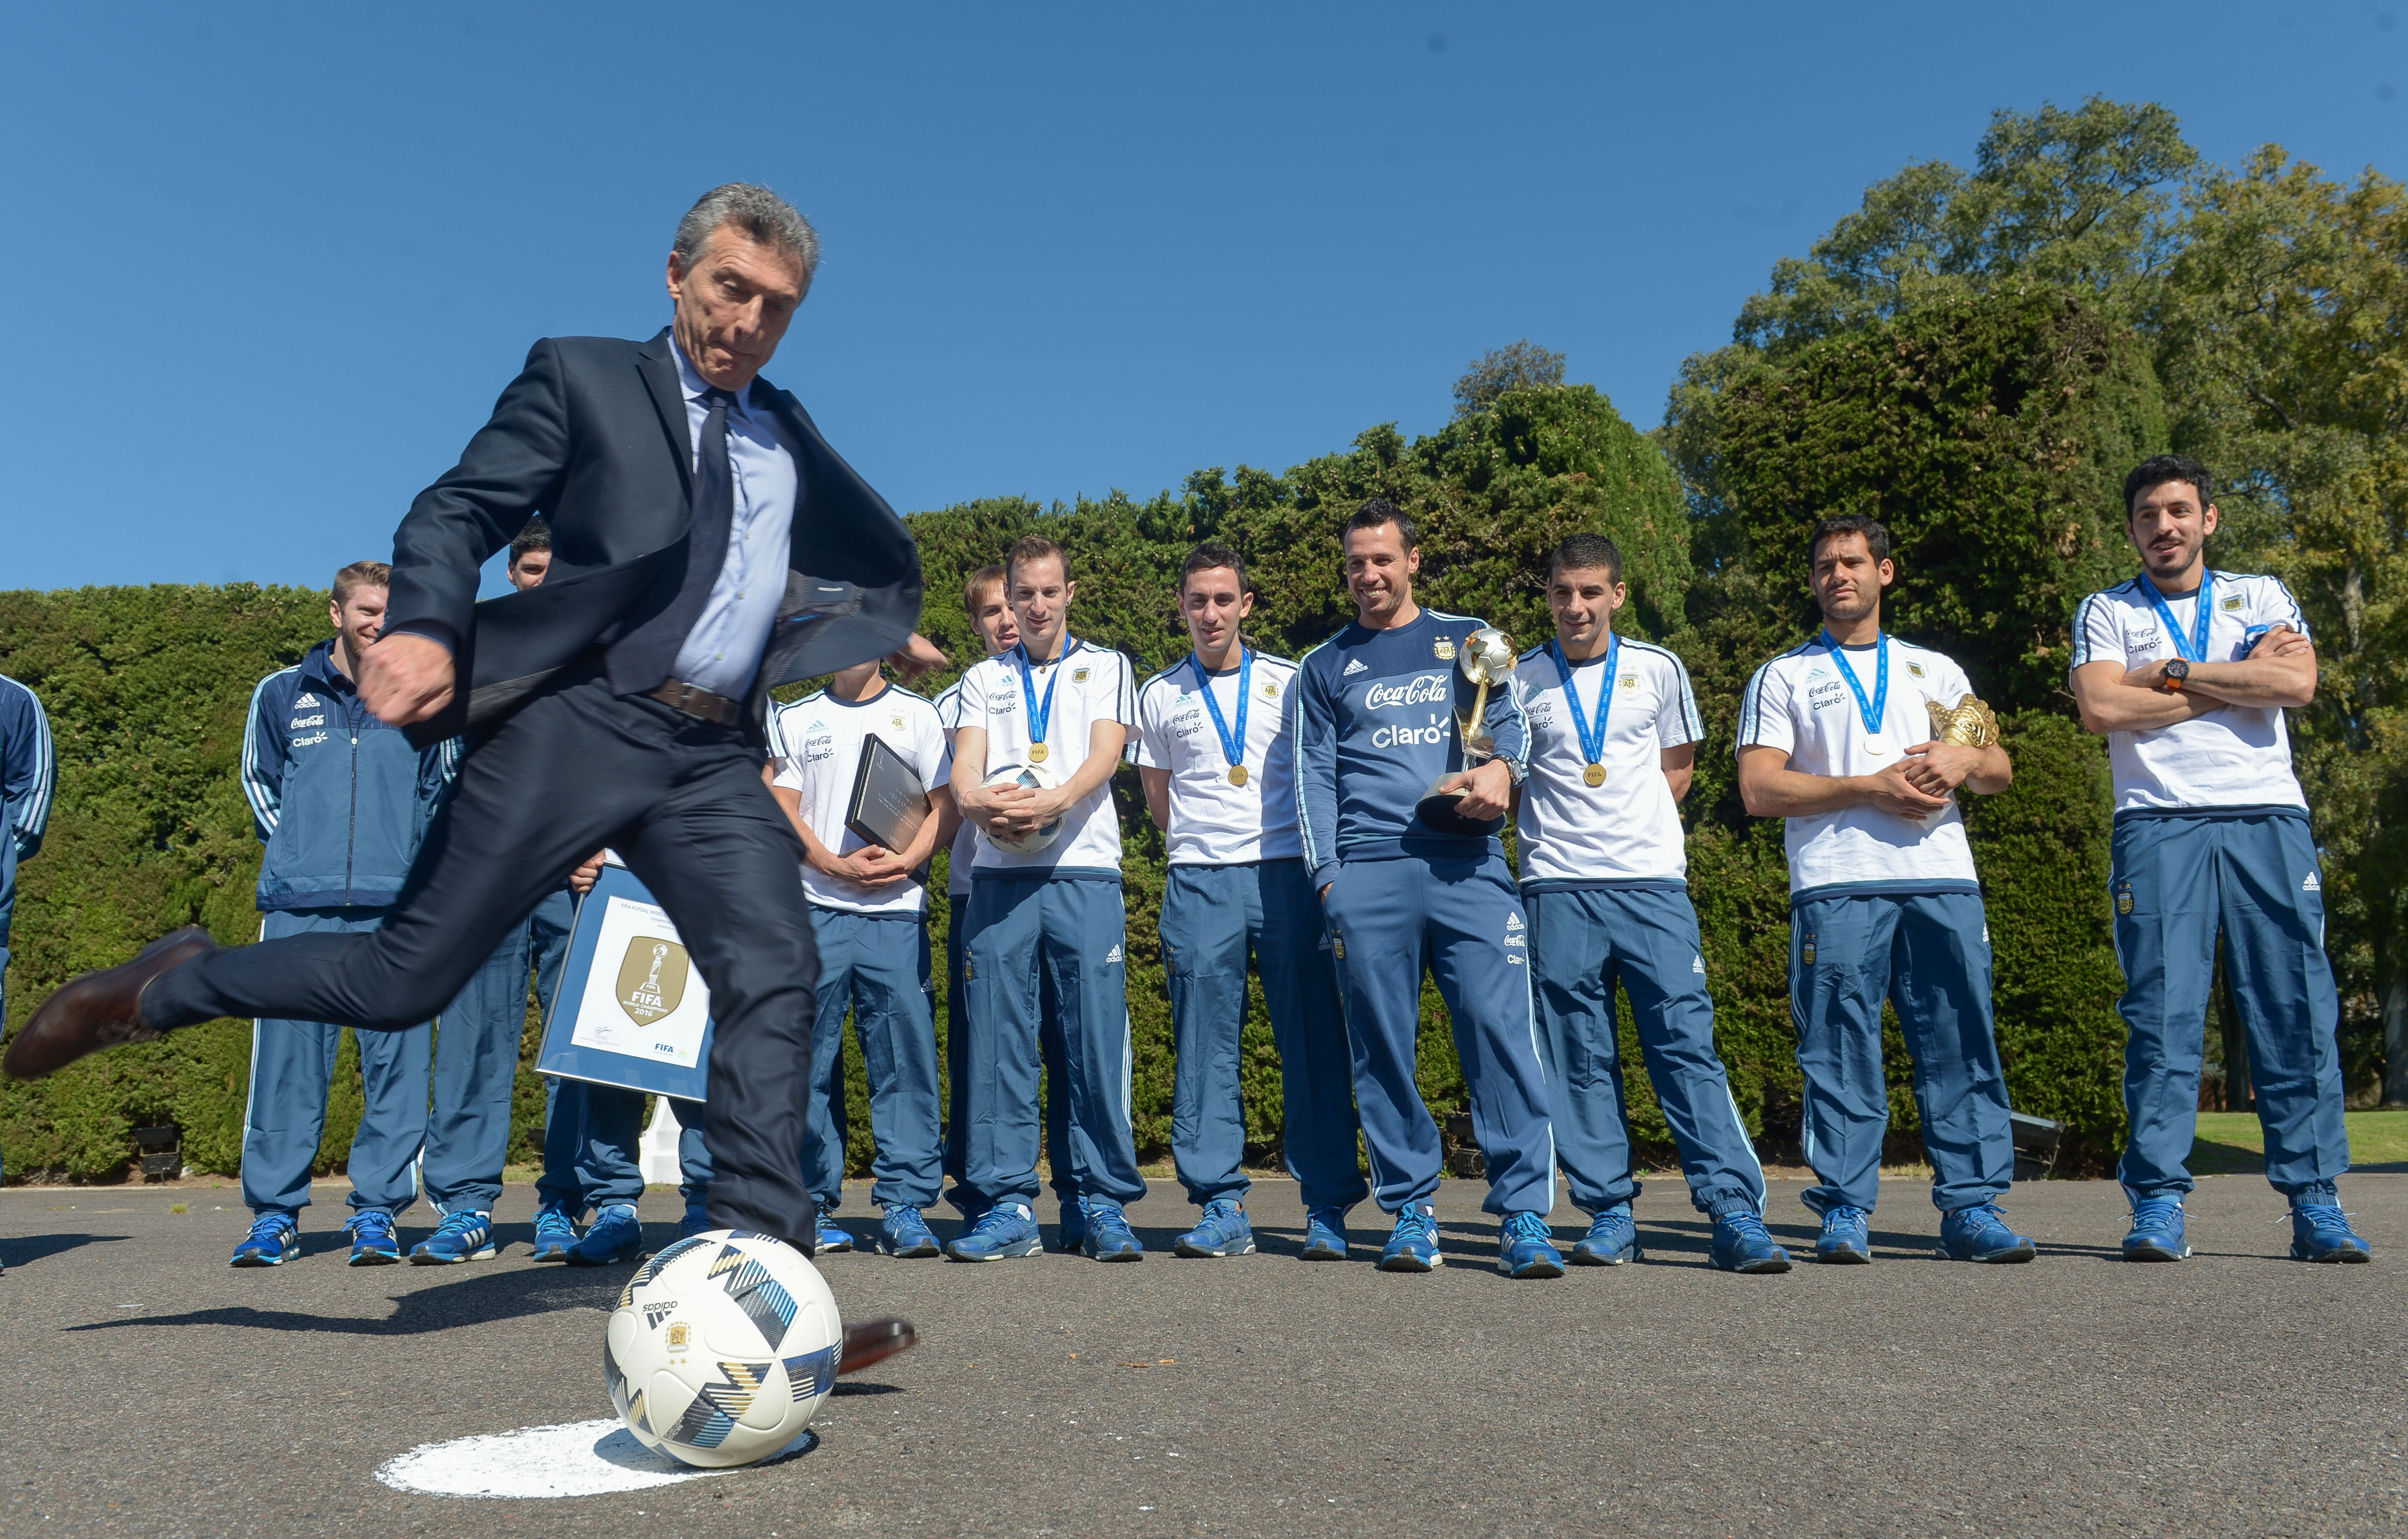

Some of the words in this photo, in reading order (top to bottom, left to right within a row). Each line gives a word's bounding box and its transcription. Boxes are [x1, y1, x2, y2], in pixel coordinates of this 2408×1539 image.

[2129, 639, 2159, 654] Claro
[1343, 665, 1368, 676] adidas
[1624, 679, 1635, 688] AFA
[1809, 681, 1840, 697] Coca-Cola
[990, 691, 1016, 700] Coca-Cola
[1365, 674, 1448, 710] Coca-Cola
[1525, 702, 1552, 715] oca-Cola
[1813, 695, 1844, 710] Claro
[989, 704, 1013, 715] Claro
[291, 714, 324, 729] Coca-Cola
[1173, 709, 1200, 724] Coca-Cola
[1177, 724, 1200, 738] Claro
[1530, 719, 1550, 731] laro
[1372, 719, 1446, 748] Claro
[293, 734, 324, 747] Claro
[805, 735, 831, 749] Coca-Cola
[807, 750, 831, 762] Claro
[632, 991, 662, 1007] FIFA
[635, 1008, 653, 1017] 2016
[641, 1004, 668, 1013] CHAMPIONS
[655, 1043, 673, 1053] FIFA
[643, 1301, 678, 1313] adidas
